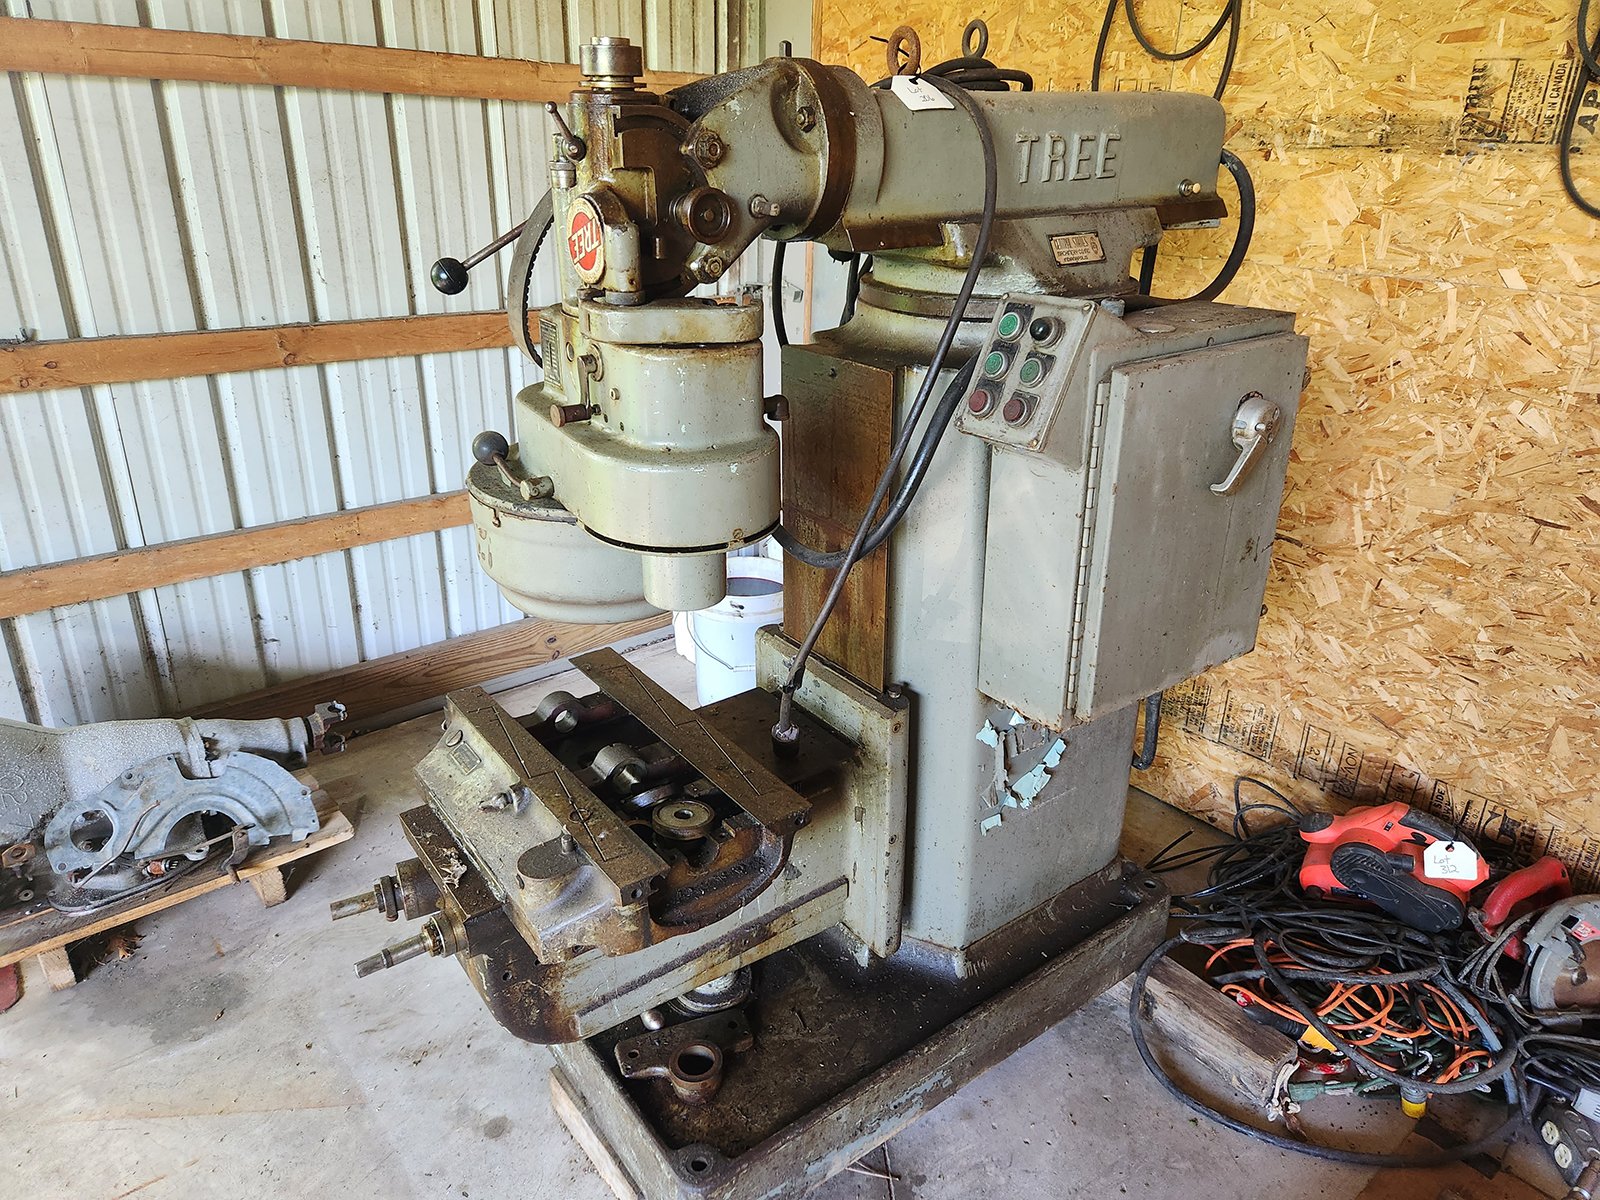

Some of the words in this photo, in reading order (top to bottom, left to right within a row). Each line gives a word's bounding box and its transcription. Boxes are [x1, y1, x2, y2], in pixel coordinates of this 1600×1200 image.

[1550, 62, 1568, 98] CANADA
[1548, 101, 1557, 110] IN
[1016, 130, 1121, 184] TREE
[572, 218, 600, 265] TREE
[1434, 788, 1445, 809] SIDE
[1433, 855, 1451, 864] Lot
[1440, 865, 1460, 875] 312
